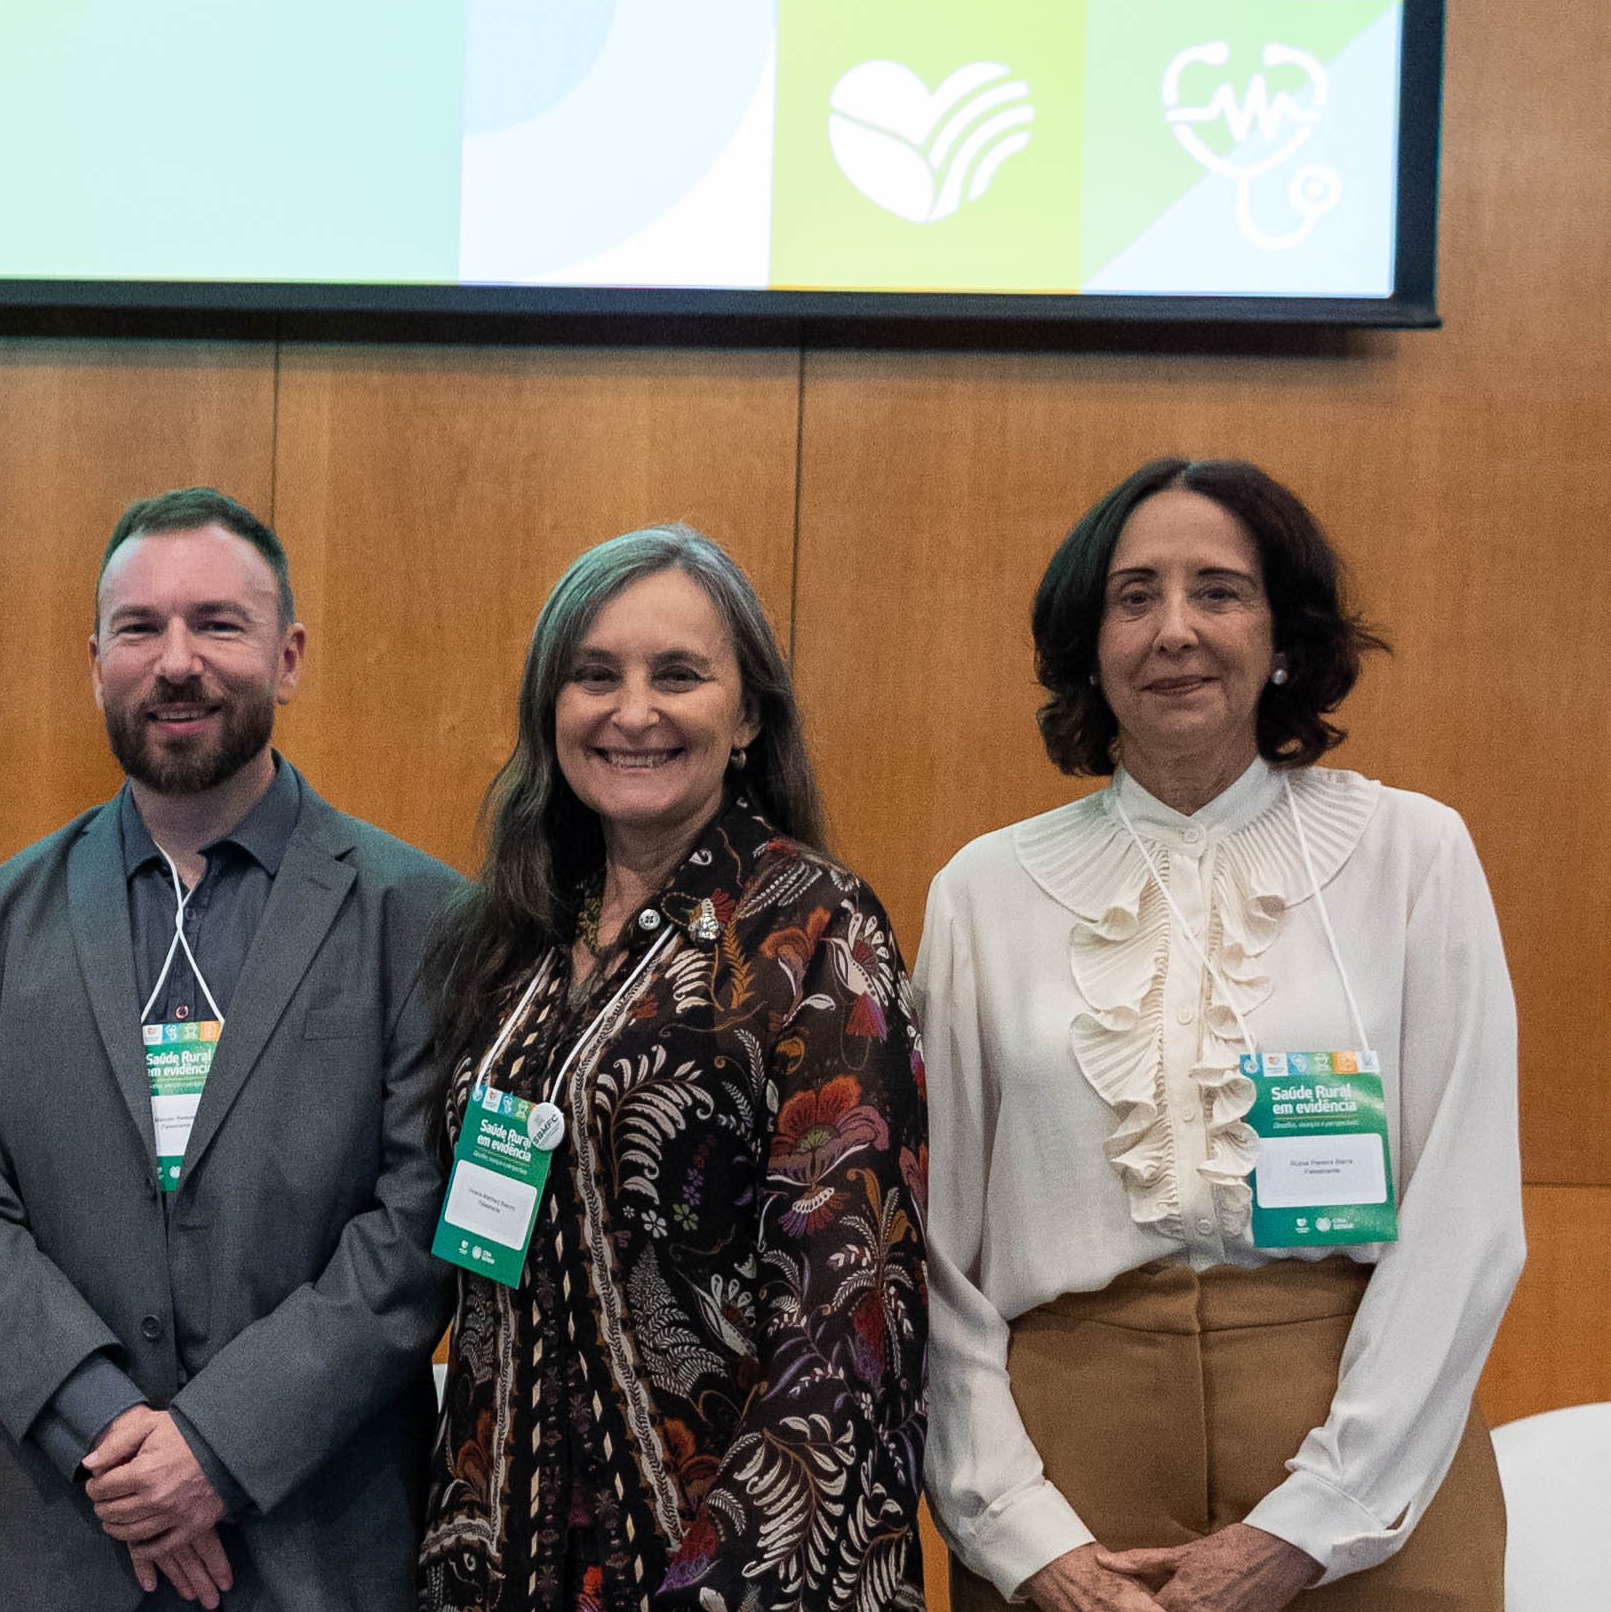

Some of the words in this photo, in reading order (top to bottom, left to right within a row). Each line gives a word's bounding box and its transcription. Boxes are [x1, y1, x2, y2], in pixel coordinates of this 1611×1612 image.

[146, 1050, 180, 1066] Saúde
[181, 1048, 212, 1064] Rural
[163, 1061, 211, 1077] evidênci
[1270, 1084, 1313, 1101] Saúde
[1314, 1083, 1352, 1099] Rural
[1272, 1102, 1293, 1115] em
[1295, 1098, 1357, 1114] evidência
[479, 1118, 508, 1140] Saúde
[507, 1128, 532, 1149] Rura
[476, 1134, 491, 1147] em
[491, 1138, 532, 1162] evidência
